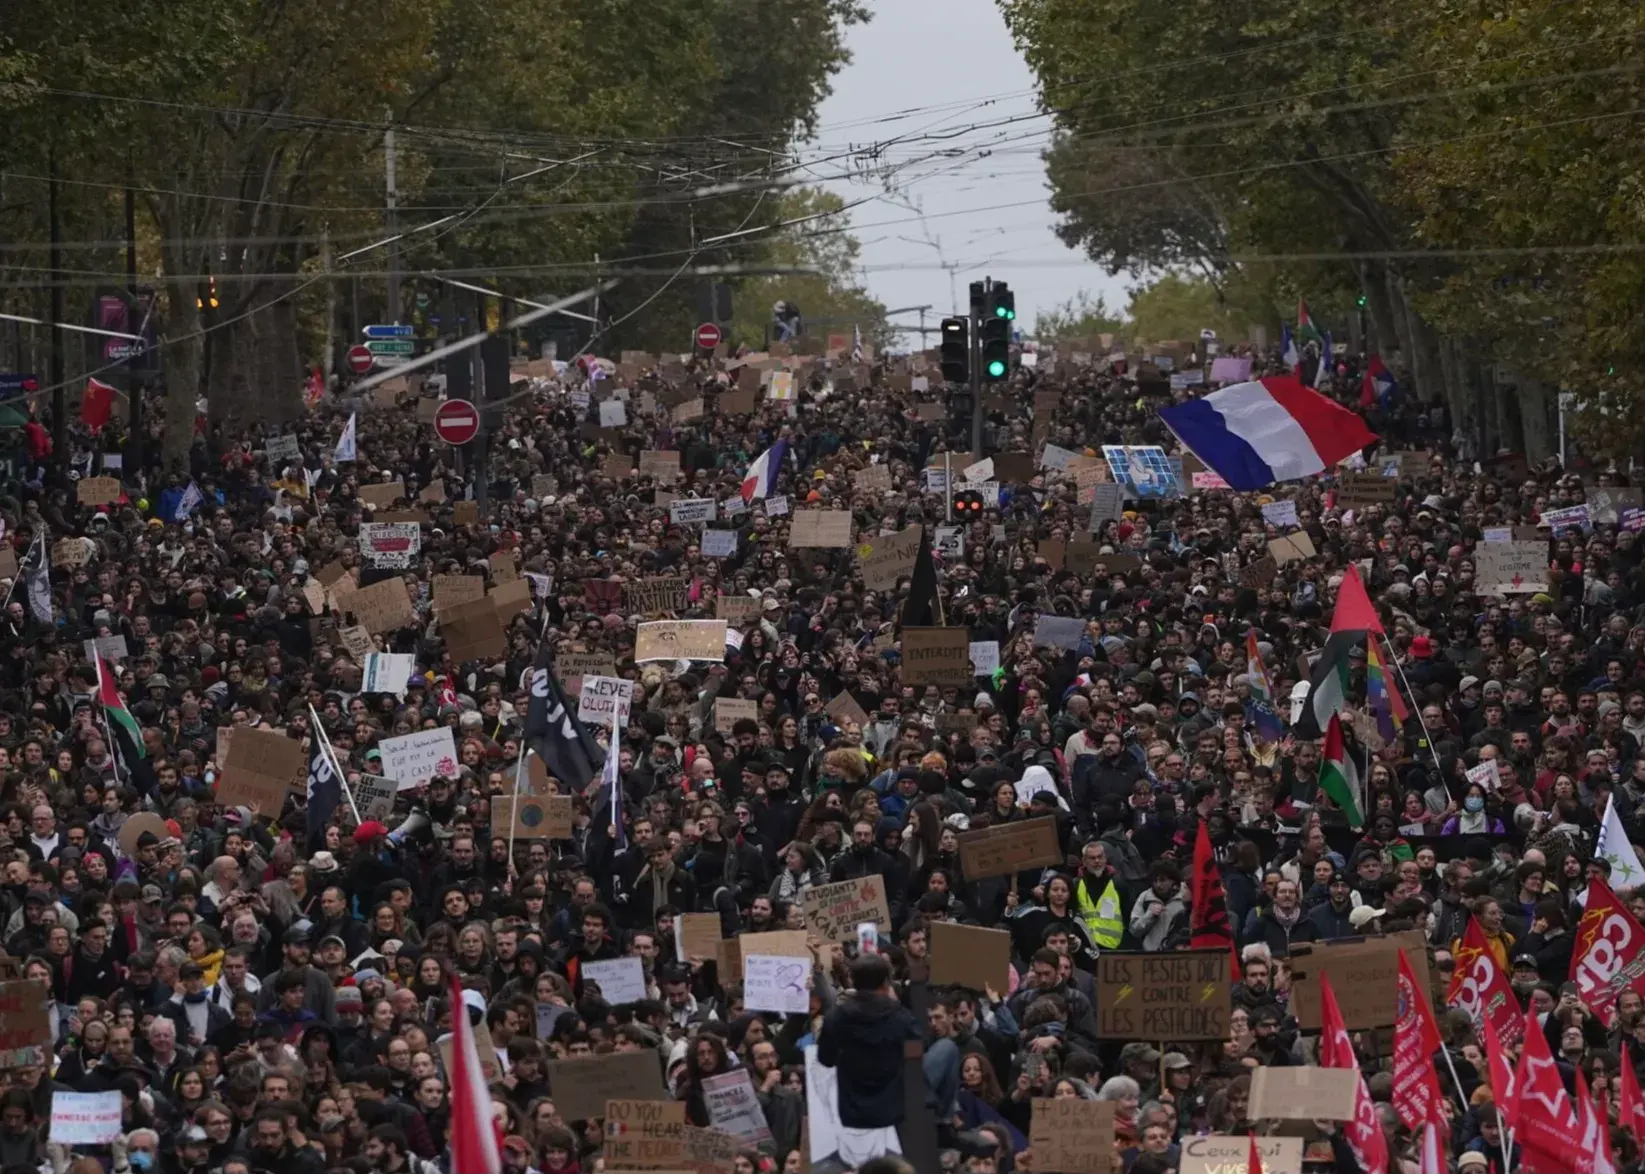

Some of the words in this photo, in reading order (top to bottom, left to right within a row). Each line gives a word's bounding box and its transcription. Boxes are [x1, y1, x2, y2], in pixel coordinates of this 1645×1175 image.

[908, 646, 965, 661] INTERDIT
[582, 697, 629, 716] OLUTIN
[805, 881, 857, 902] ETUDIANTS
[808, 909, 838, 940] ACAB
[1103, 959, 1133, 984] LES
[1142, 957, 1192, 984] PESTES
[1141, 985, 1192, 1003] CONTRE
[1102, 1007, 1134, 1035] LES
[1142, 1004, 1225, 1037] PESTICIDES
[610, 1103, 632, 1121] DO
[636, 1104, 664, 1121] YOU
[643, 1123, 685, 1140] HEAR
[604, 1141, 633, 1159] THE
[639, 1140, 683, 1158] PEOPLE
[1187, 1138, 1243, 1158] Ceux
